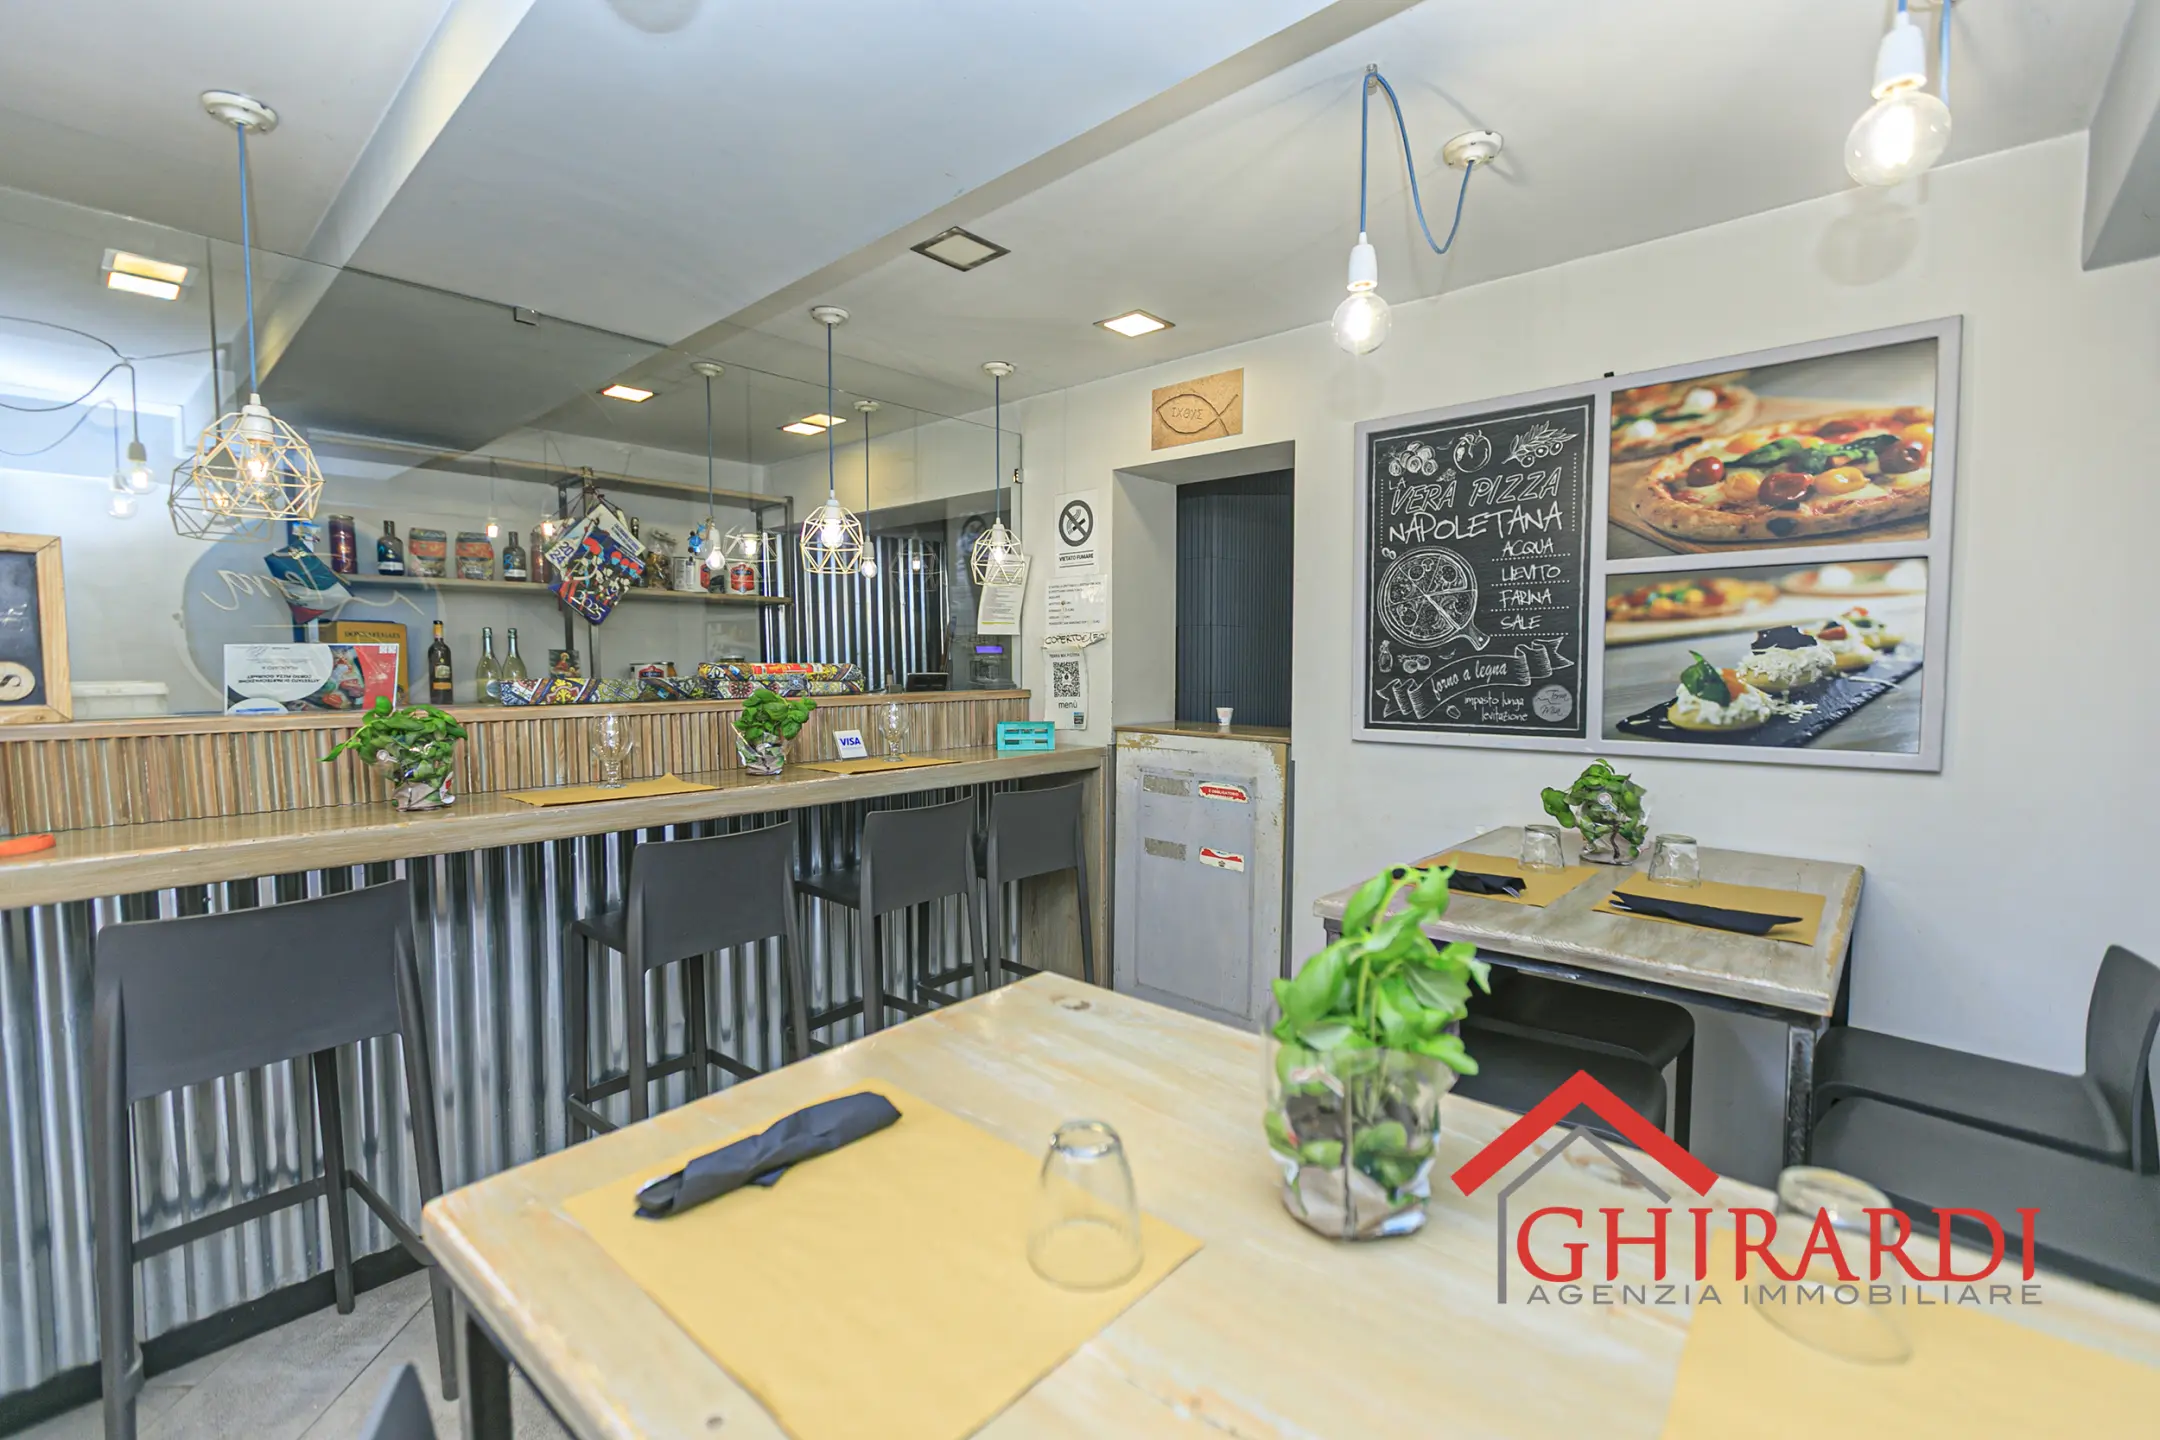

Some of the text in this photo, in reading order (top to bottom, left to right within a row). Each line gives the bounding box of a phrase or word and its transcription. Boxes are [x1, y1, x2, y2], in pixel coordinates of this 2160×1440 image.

[1389, 477, 1407, 490] LA
[1391, 467, 1562, 515] VERA PIZZA
[1389, 501, 1563, 544] NAPOLETANA
[1502, 537, 1553, 557] ACQUA
[1059, 554, 1076, 562] VIETATO
[1502, 564, 1561, 582] LIEVITO
[1499, 588, 1552, 609] FARINA
[1500, 614, 1542, 630] SALE
[1463, 669, 1471, 681] a
[1474, 660, 1508, 684] legna
[1464, 690, 1499, 710] impasto
[840, 737, 861, 746] VISA
